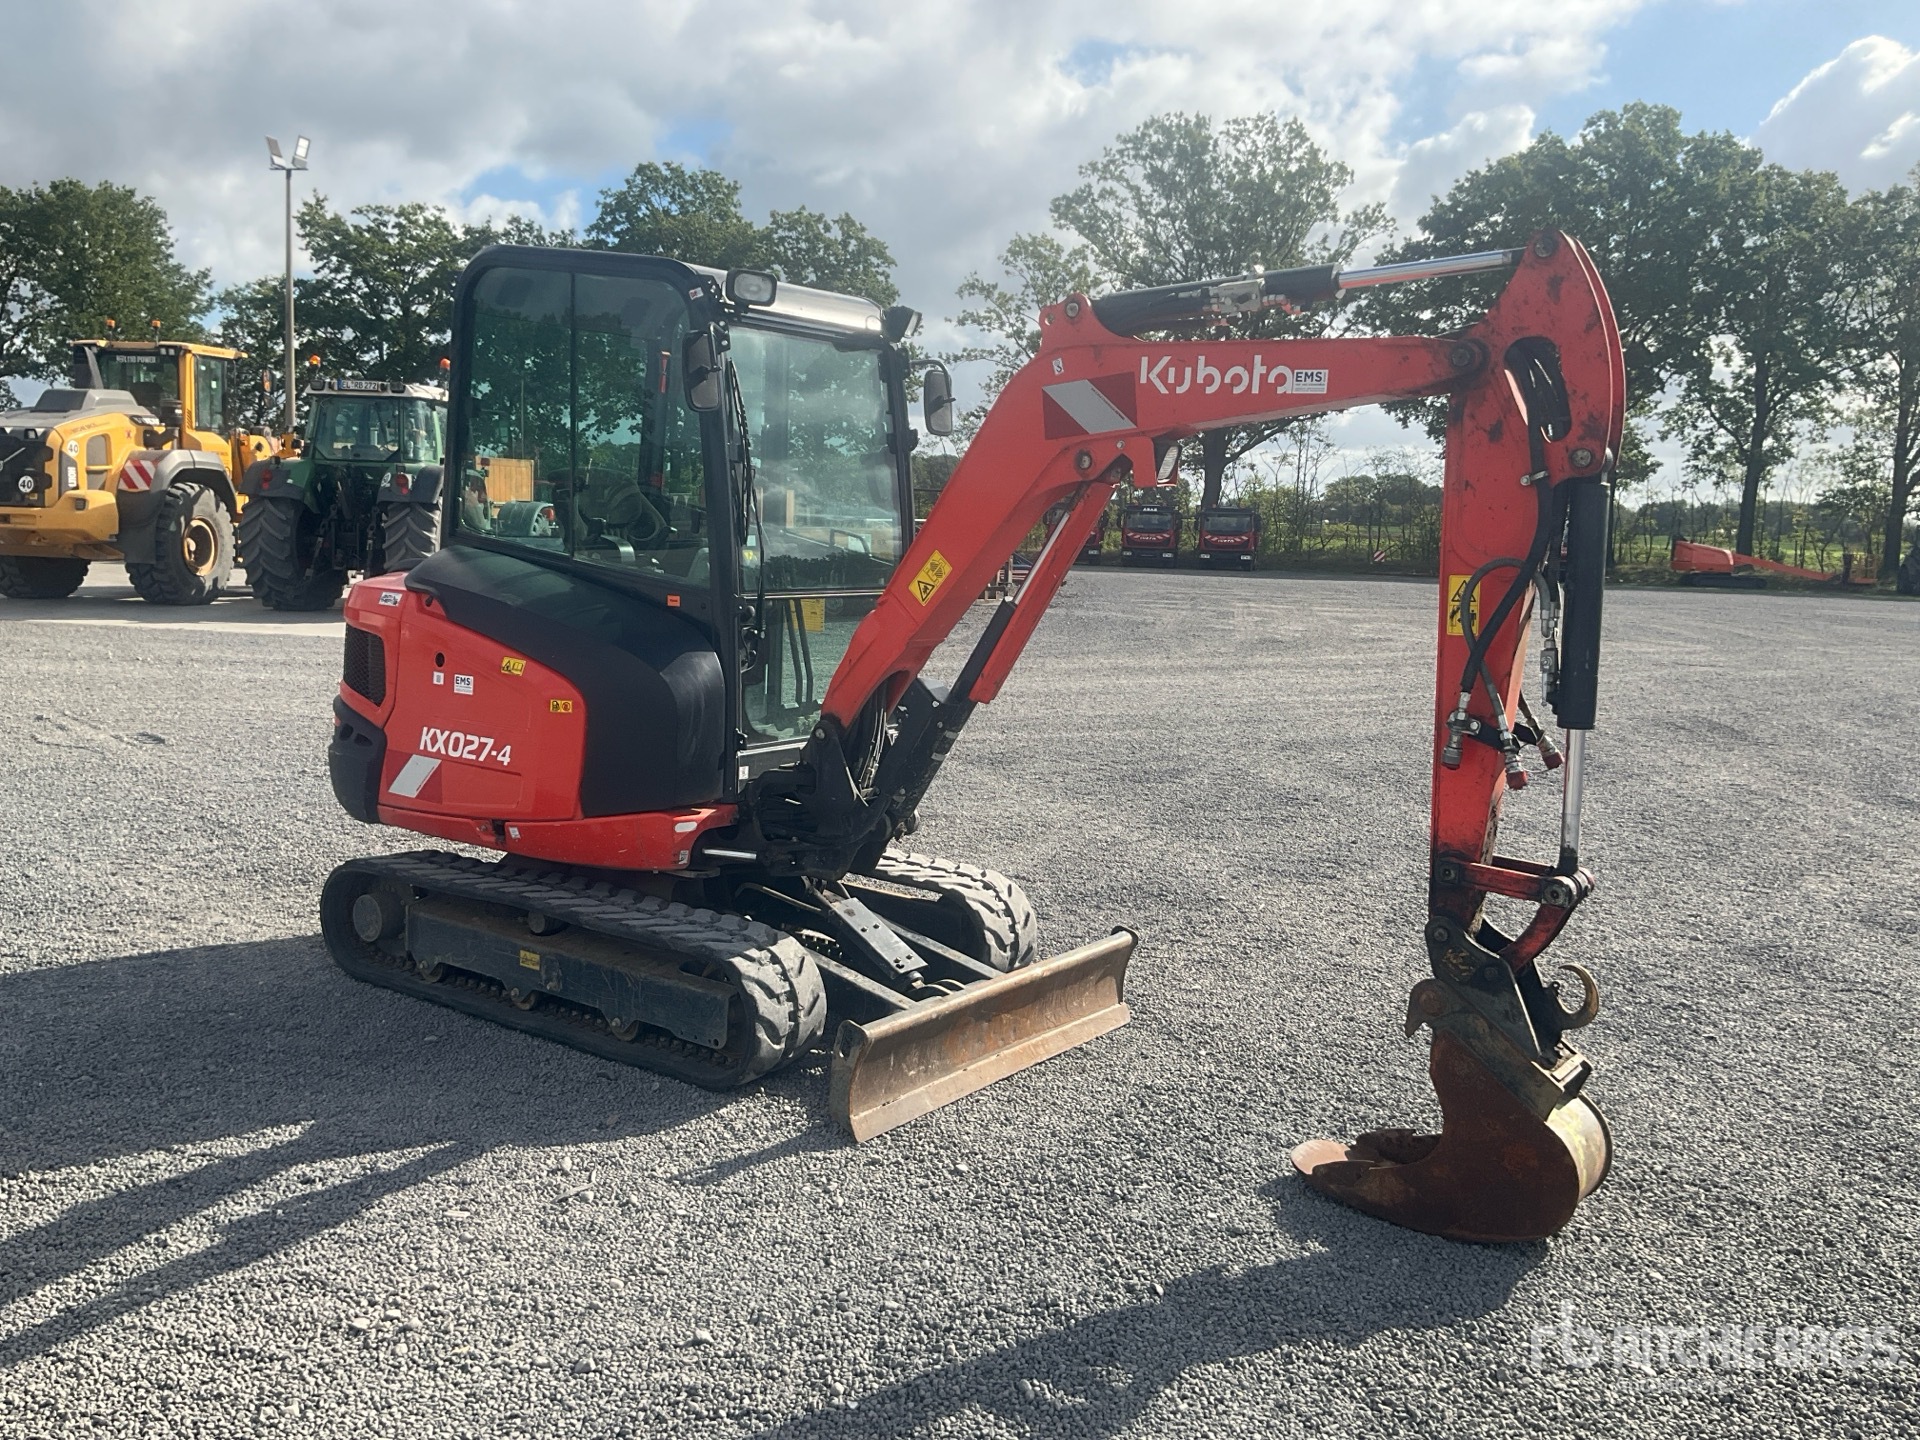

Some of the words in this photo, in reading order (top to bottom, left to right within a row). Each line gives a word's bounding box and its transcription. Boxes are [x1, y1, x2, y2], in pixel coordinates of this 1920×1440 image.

[1139, 354, 1294, 394] Kubota
[1295, 371, 1323, 383] EMS
[68, 443, 79, 453] 40
[19, 479, 33, 490] 40
[455, 676, 471, 686] EMS
[419, 726, 512, 766] KX027-4
